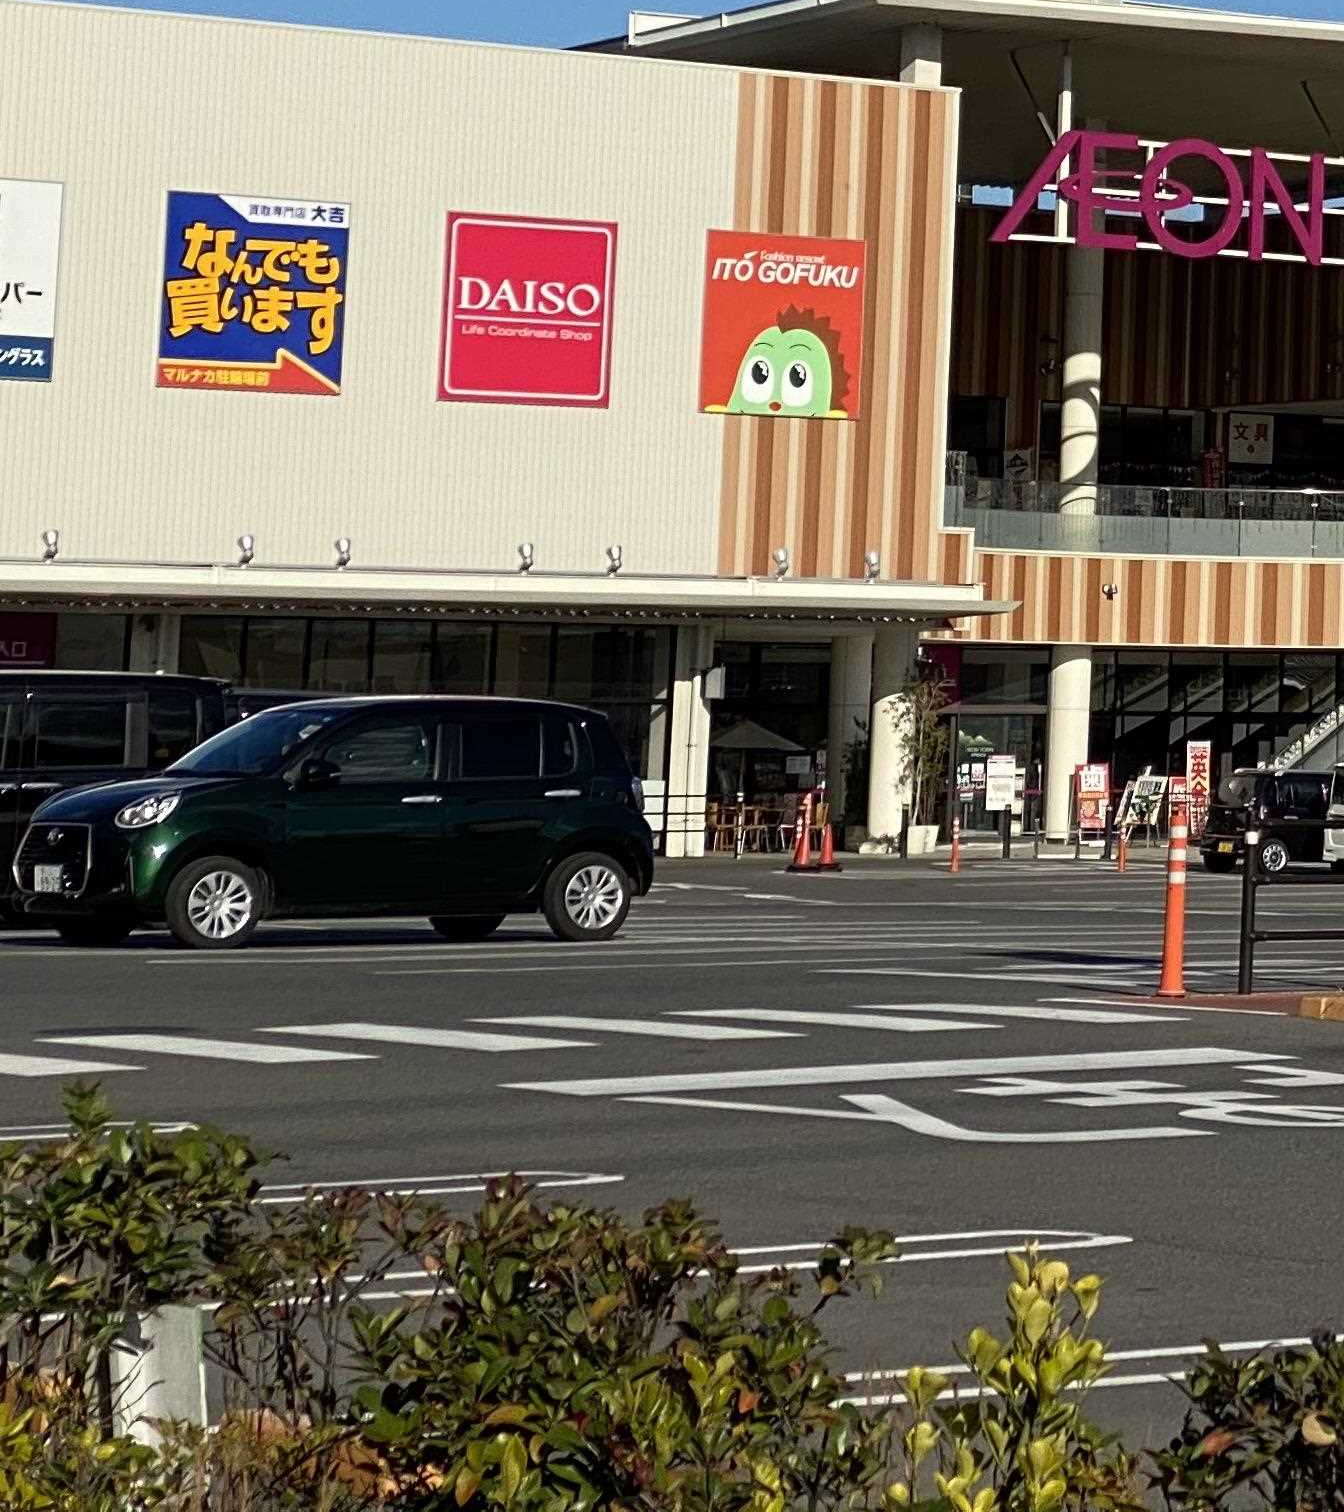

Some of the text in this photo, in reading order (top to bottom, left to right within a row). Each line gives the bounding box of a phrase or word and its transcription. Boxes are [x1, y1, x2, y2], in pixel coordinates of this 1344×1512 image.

[311, 205, 345, 223] 大吉
[181, 222, 340, 284] なんでも
[758, 262, 859, 288] GOFUKU
[456, 276, 600, 316] DAISO
[167, 277, 343, 354] 買います
[462, 325, 592, 342] Life Coordinate Shop
[1233, 422, 1268, 441] 文具
